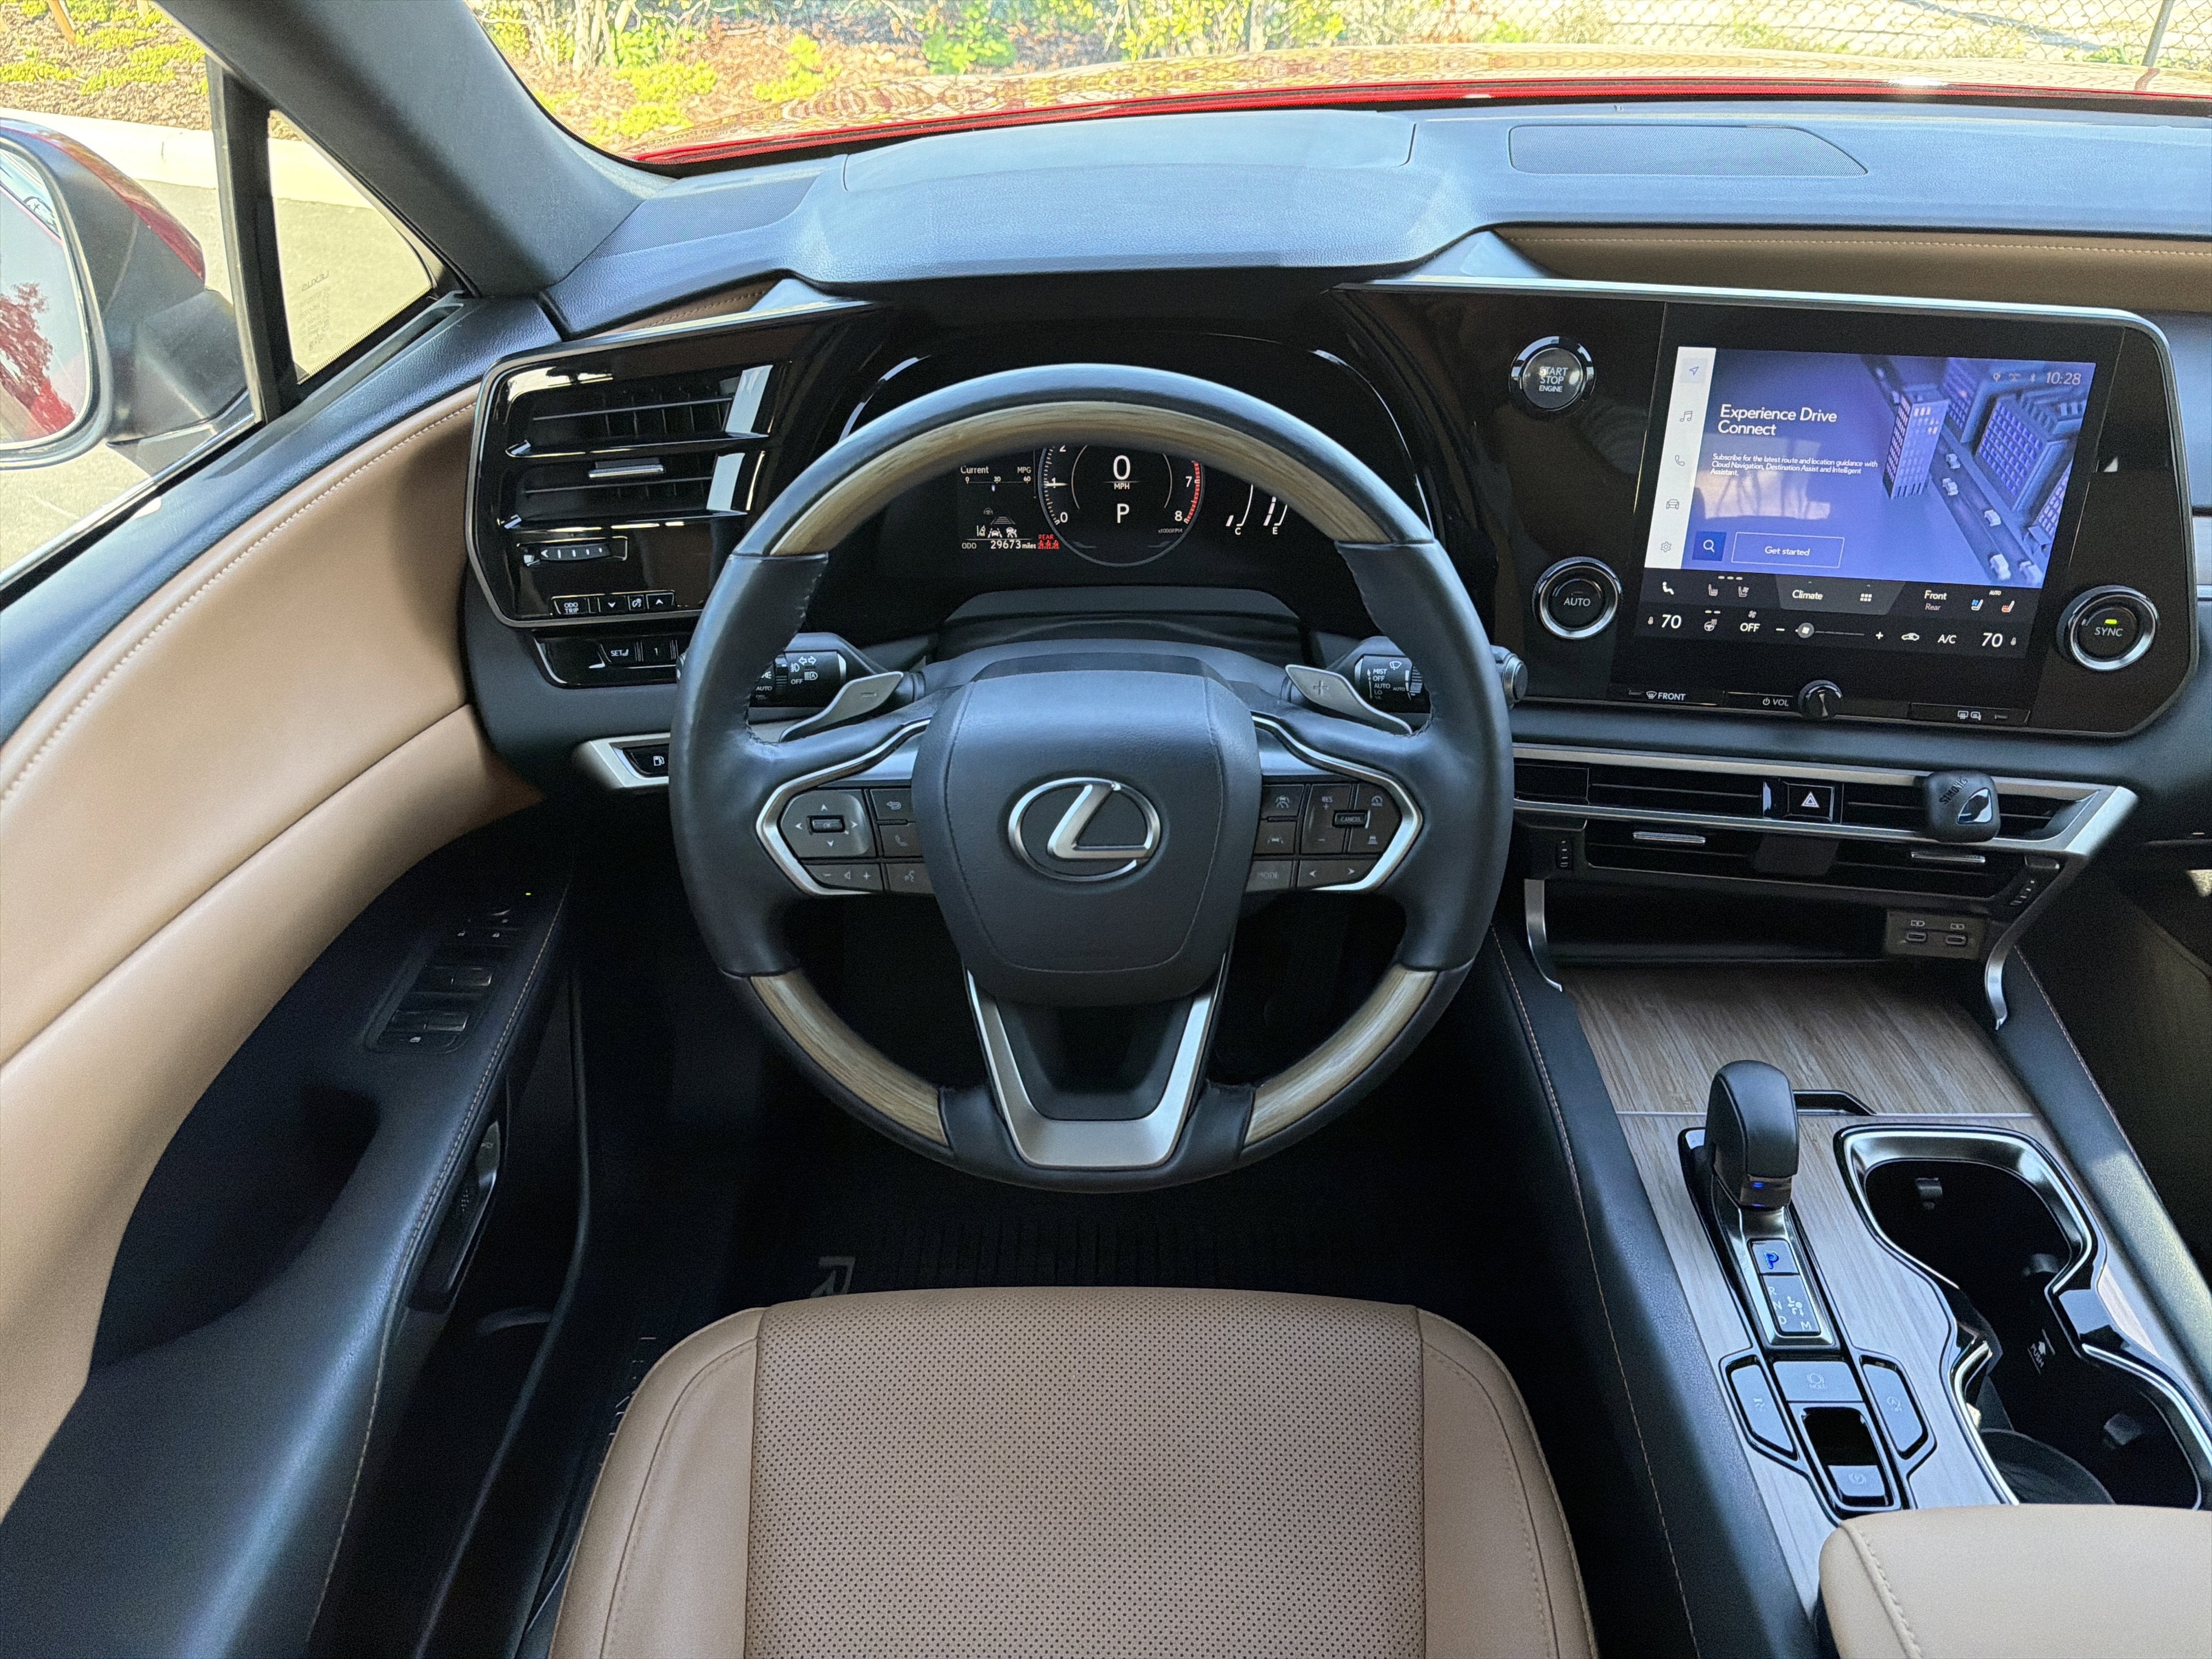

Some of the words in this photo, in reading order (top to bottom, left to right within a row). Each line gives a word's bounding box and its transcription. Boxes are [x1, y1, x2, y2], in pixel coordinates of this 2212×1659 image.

[1539, 366, 1568, 376] START
[1540, 376, 1564, 385] STOP
[2046, 372, 2081, 385] 10:28
[1539, 385, 1563, 393] ENGINE
[1720, 404, 1797, 422] Experience
[1799, 407, 1837, 423] Drive
[1718, 420, 1776, 436] Connect
[1713, 453, 1742, 461] Subscribe
[961, 466, 989, 474] Current
[1113, 455, 1131, 480] 0
[1731, 461, 1764, 471] Navigation,
[1801, 464, 1819, 472] Assist
[1832, 466, 1862, 475] Intelligent
[1185, 476, 1193, 488] 7
[1060, 512, 1068, 523] 0
[1116, 503, 1130, 523] P
[1175, 511, 1183, 522] 8
[1234, 527, 1242, 535] C
[1272, 527, 1278, 535] E
[990, 540, 1022, 549] 29673
[1764, 546, 1780, 555] Get
[1782, 548, 1810, 556] started
[1792, 589, 1823, 600] Climate
[1925, 590, 1947, 601] Front
[1564, 597, 1591, 607] AUTO
[1661, 614, 1682, 629] 70
[1740, 622, 1760, 633] OFF
[2095, 627, 2124, 637] SYNC
[1938, 634, 1957, 644] A/C
[1982, 632, 2003, 648] 70
[654, 647, 658, 656] 1
[1658, 692, 1686, 701] FRONT
[1773, 698, 1789, 707] VOL
[1763, 1249, 1780, 1270] P
[1767, 1286, 1778, 1296] R
[1772, 1300, 1783, 1311] N
[1778, 1315, 1787, 1325] D
[1801, 1321, 1813, 1331] M
